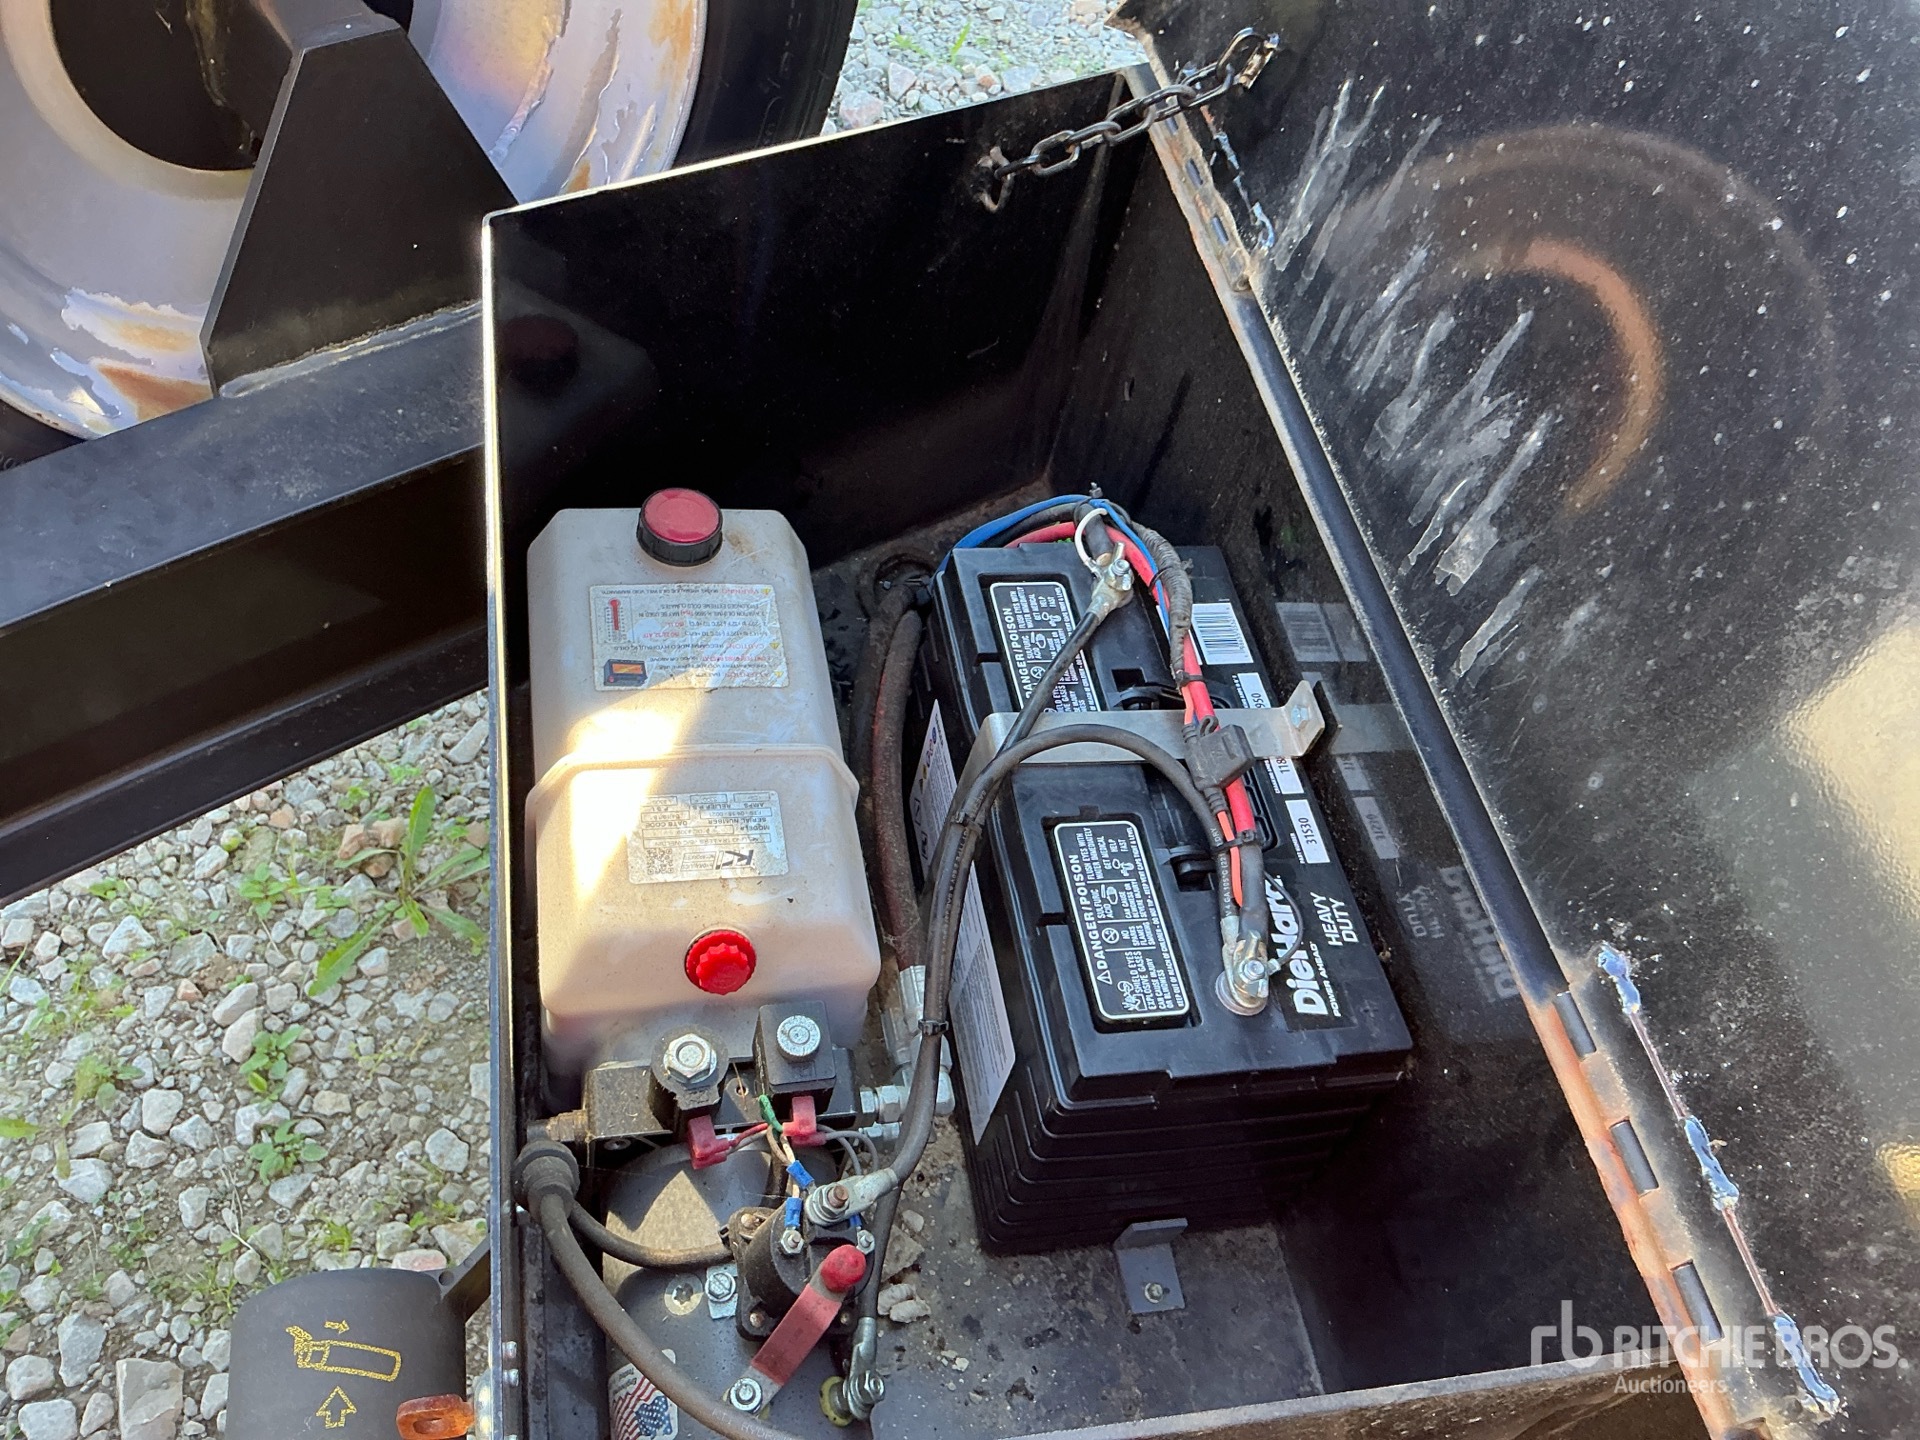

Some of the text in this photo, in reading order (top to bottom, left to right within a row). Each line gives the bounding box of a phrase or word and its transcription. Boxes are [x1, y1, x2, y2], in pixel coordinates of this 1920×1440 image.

[1249, 692, 1265, 708] 950
[1108, 839, 1118, 852] HELP
[1118, 839, 1128, 852] FAST
[1297, 817, 1317, 844] 31S30
[1076, 833, 1095, 880] FLUSH EYES WITH
[1096, 836, 1112, 870] GET MEDICAL
[1092, 862, 1104, 879] WATER
[1068, 854, 1108, 970] DANGER/POISON
[1090, 889, 1106, 918] SULFURIC
[1103, 903, 1114, 918] ACID
[1310, 892, 1343, 946] HEAVY
[1121, 930, 1130, 939] NO
[1329, 897, 1359, 943] DUTY
[1124, 951, 1144, 994] SHIELD EYES
[1133, 951, 1157, 1010] EXPLOSIVE GASES
[1309, 942, 1342, 1017] POWER AHEAD
